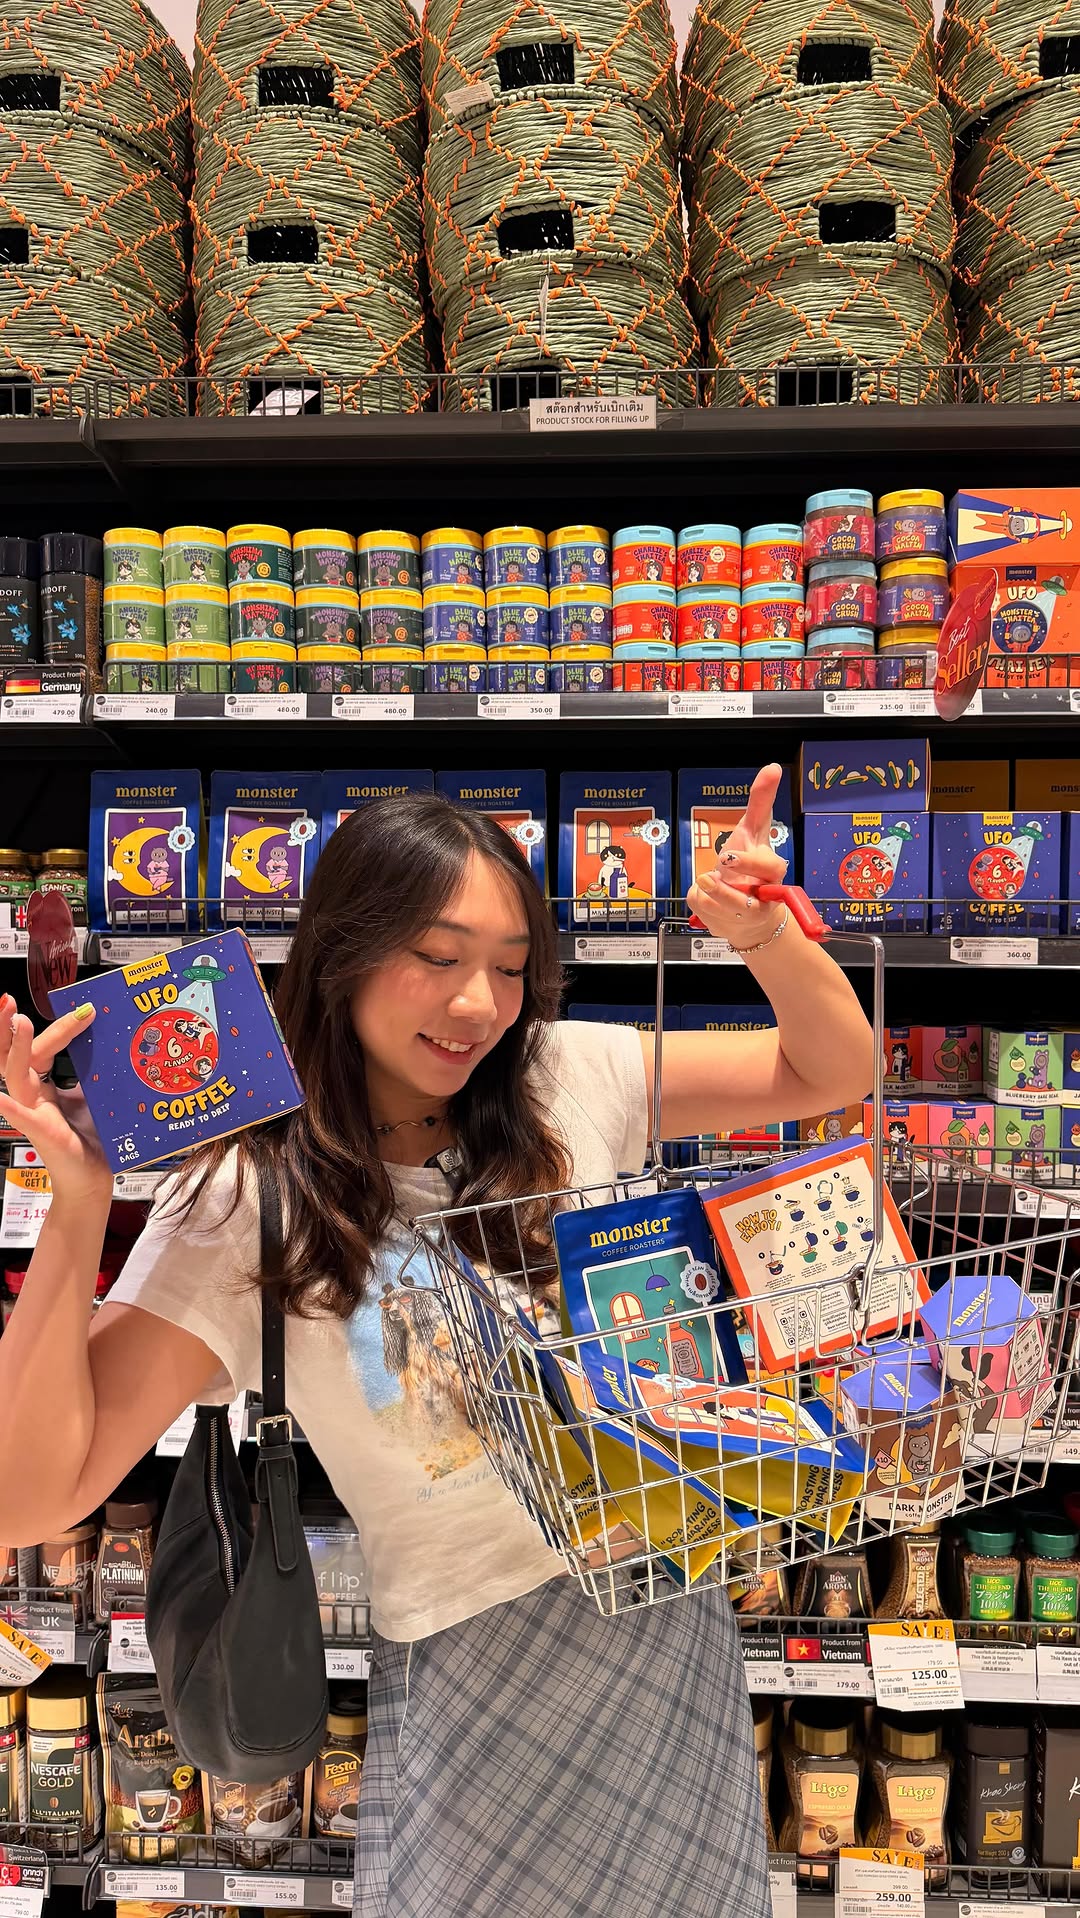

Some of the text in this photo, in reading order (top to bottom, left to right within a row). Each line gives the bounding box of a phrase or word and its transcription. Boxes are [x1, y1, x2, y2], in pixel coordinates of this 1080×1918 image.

[546, 400, 644, 414] สต๊อกสำหรับเบิกเติม
[536, 417, 569, 425] PRODUCT
[572, 416, 594, 424] STOCK
[596, 416, 610, 424] FOR
[832, 536, 856, 544] COCOA
[896, 535, 920, 544] COCOA
[633, 546, 668, 556] CHARLIE'S
[832, 542, 856, 551] CRUSH
[454, 550, 472, 560] BLUE
[504, 550, 522, 558] BLUE
[567, 550, 585, 558] BLUE
[449, 558, 476, 568] MATCHA
[499, 558, 528, 567] MATCHA
[562, 556, 590, 567] MATCHA
[1008, 586, 1037, 600] UFO
[455, 608, 472, 616] BLUE
[502, 608, 520, 616] BLUE
[568, 608, 586, 616] BLUE
[692, 605, 728, 616] CHARLIE'S
[760, 604, 796, 614] CHARLIE'S
[836, 603, 860, 612] COCOA
[836, 608, 859, 618] CRUSH
[906, 604, 930, 612] COCOA
[1000, 608, 1040, 618] MONSTER'S
[449, 615, 476, 625] MATCHA
[498, 616, 526, 625] MATCHA
[563, 614, 592, 624] MATCHA
[948, 616, 972, 649] Best
[936, 642, 988, 696] Seller
[42, 682, 81, 693] Germany
[115, 785, 177, 798] monster
[236, 787, 298, 799] monster
[346, 785, 408, 797] monster
[460, 787, 522, 799] monster
[584, 787, 646, 799] monster
[852, 832, 882, 845] UFO
[984, 832, 1012, 845] UFO
[862, 865, 871, 878] 6
[992, 865, 1002, 878] 6
[128, 960, 163, 976] monster
[132, 984, 179, 1014] UFO
[167, 1038, 183, 1058] 6
[163, 1052, 193, 1068] FLAVORS
[152, 1076, 236, 1121] COFFEE
[1006, 1092, 1036, 1100] BLUEBERRY
[168, 1103, 231, 1132] READY TO DRIP
[120, 1151, 140, 1163] BAGS
[20, 1170, 34, 1178] BUY
[25, 1175, 47, 1188] GET 1
[735, 1209, 777, 1232] HOW TO
[590, 1216, 672, 1249] monster
[740, 1220, 782, 1244] ENJOY!
[602, 1238, 666, 1258] COFFEE ROASTERS
[102, 1568, 144, 1582] PLATINUM
[830, 1574, 847, 1583] BON
[318, 1572, 360, 1590] flip
[740, 1582, 765, 1590] AROMA
[822, 1582, 852, 1590] AROMA
[320, 1592, 357, 1601] COFFEE
[916, 1572, 924, 1614] SELECTED
[976, 1591, 1010, 1599] ブラジル
[1037, 1592, 1073, 1601] ブラジル
[980, 1600, 1006, 1608] 100%
[1042, 1601, 1069, 1611] 100%
[55, 1606, 70, 1614] from
[41, 1616, 60, 1627] UK
[902, 1622, 943, 1640] SALE
[740, 1636, 764, 1644] Product
[8, 1630, 43, 1664] SALE
[742, 1648, 780, 1658] Vietnam
[822, 1650, 862, 1660] Vietnam
[912, 1670, 948, 1680] 125.00
[324, 1760, 357, 1775] Festa
[38, 1777, 74, 1788] GOLD
[810, 1782, 849, 1798] Ligo
[897, 1784, 936, 1800] Ligo
[980, 1780, 1026, 1800] Khao Shong
[8, 1854, 44, 1862] Switzerland
[872, 1850, 913, 1868] SALE
[876, 1893, 912, 1902] 259.00
